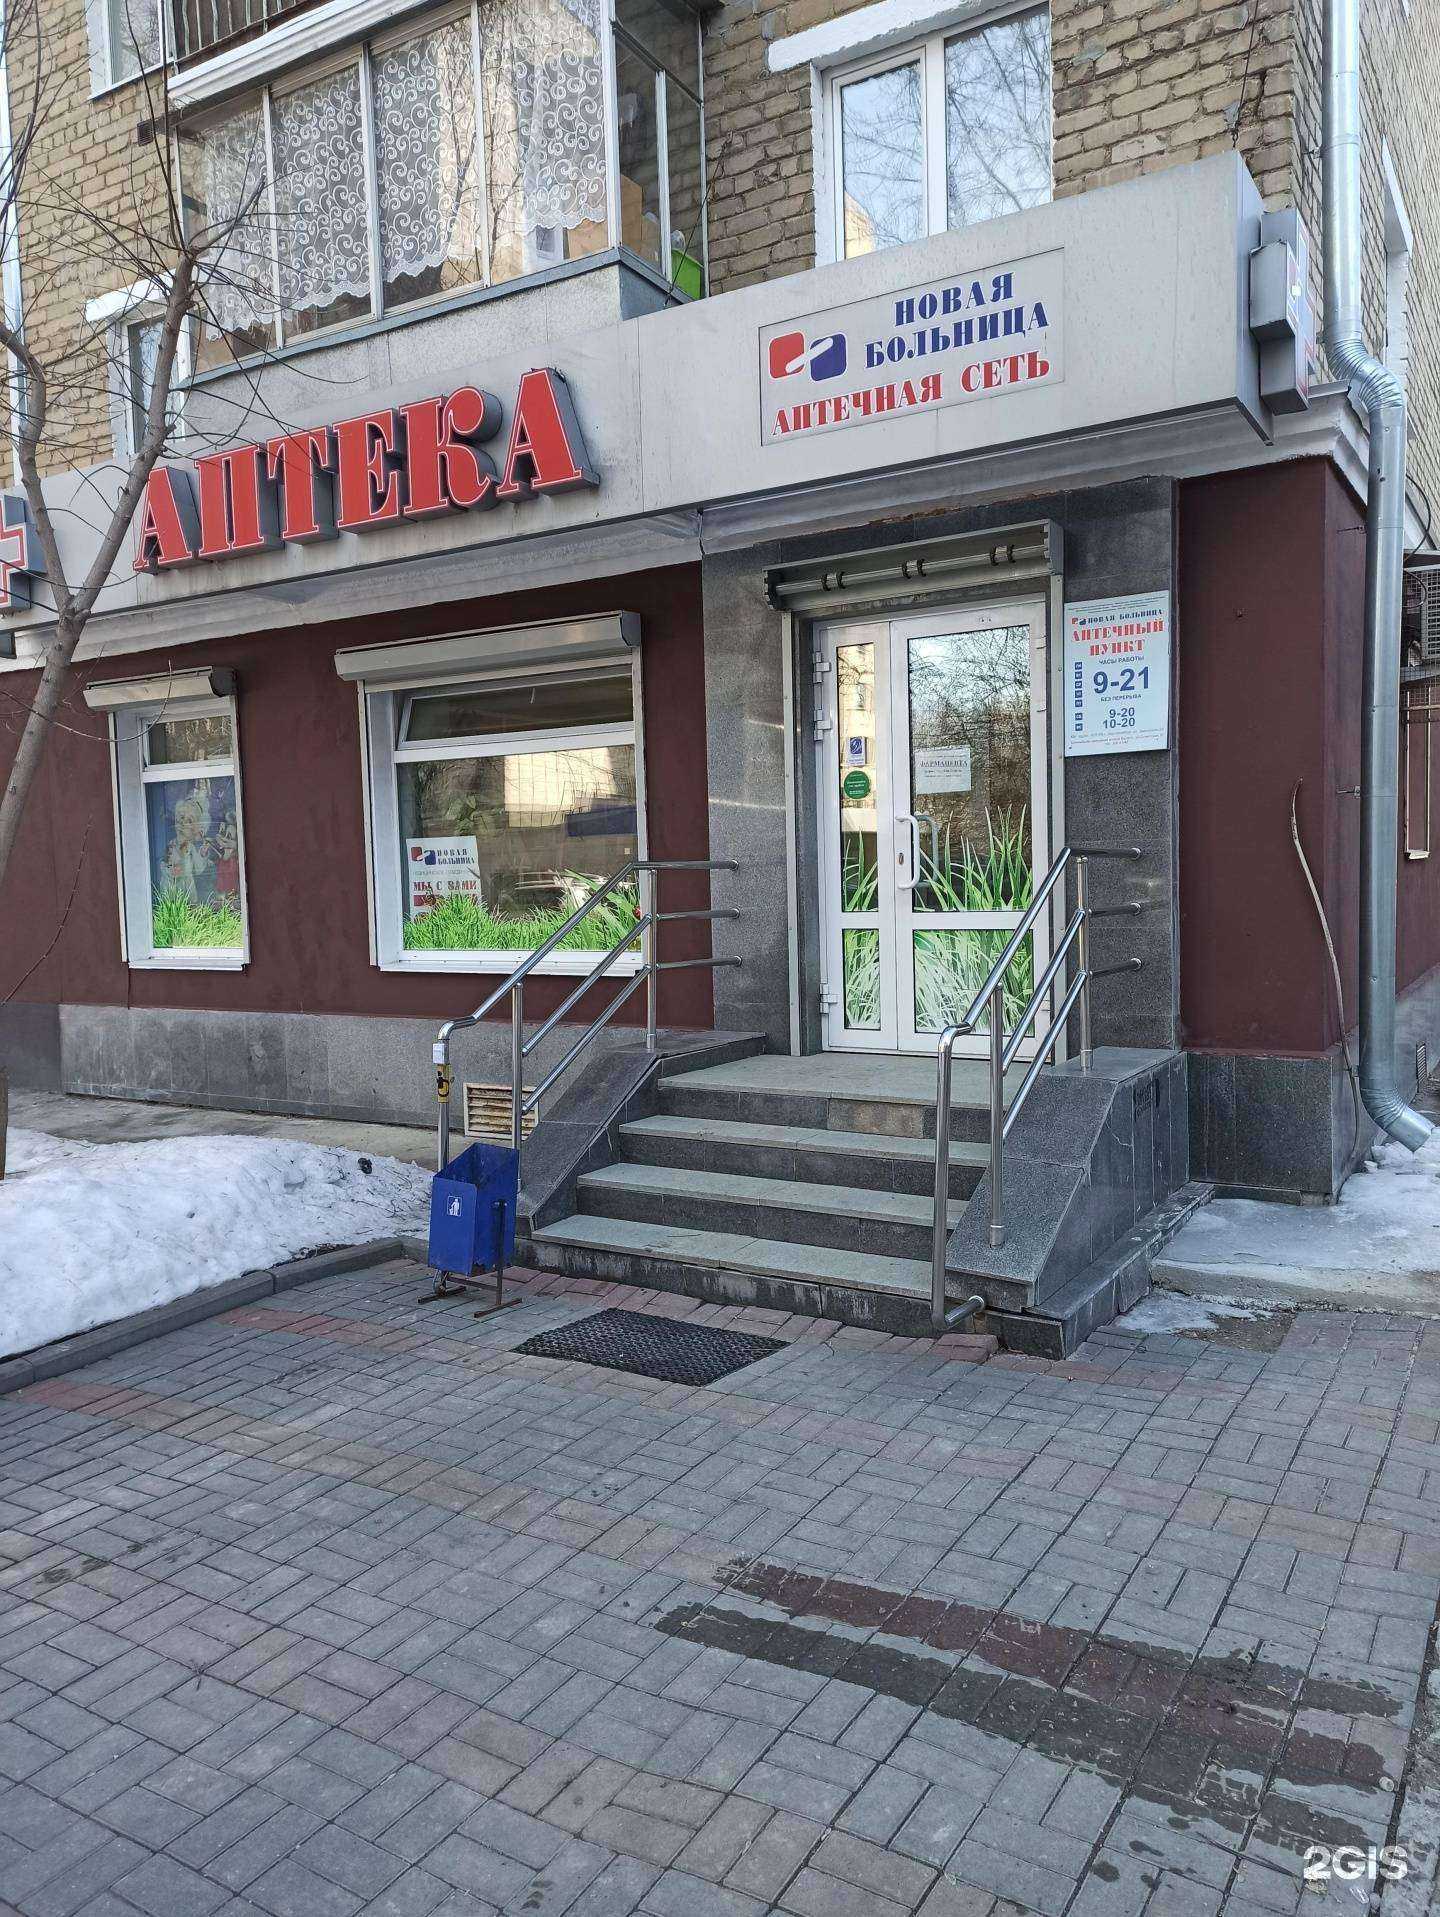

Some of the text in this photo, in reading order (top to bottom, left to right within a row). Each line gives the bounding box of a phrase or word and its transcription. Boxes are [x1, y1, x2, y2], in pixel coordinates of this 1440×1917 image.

[894, 270, 1015, 328] НОВАЯ
[864, 301, 1050, 369] БОЛЬНИЦА
[772, 350, 1051, 436] АПТЕЧНАЯ СЕТЬ
[132, 367, 586, 573] АПТЕКА
[1087, 614, 1115, 624] НОВАЯ
[1072, 618, 1164, 641] АПТЕЧНЫЙ
[1089, 639, 1146, 656] ПУНКТ
[1118, 655, 1145, 664] РАБОТЫ
[1093, 666, 1150, 694] 9-21
[1112, 693, 1142, 701] ПЕРЕРЫВА
[1109, 706, 1135, 719] 9-20
[1102, 717, 1136, 729] 10-20
[436, 848, 468, 857] НОВАЯ
[413, 880, 477, 892] МЫ С ВАМИ
